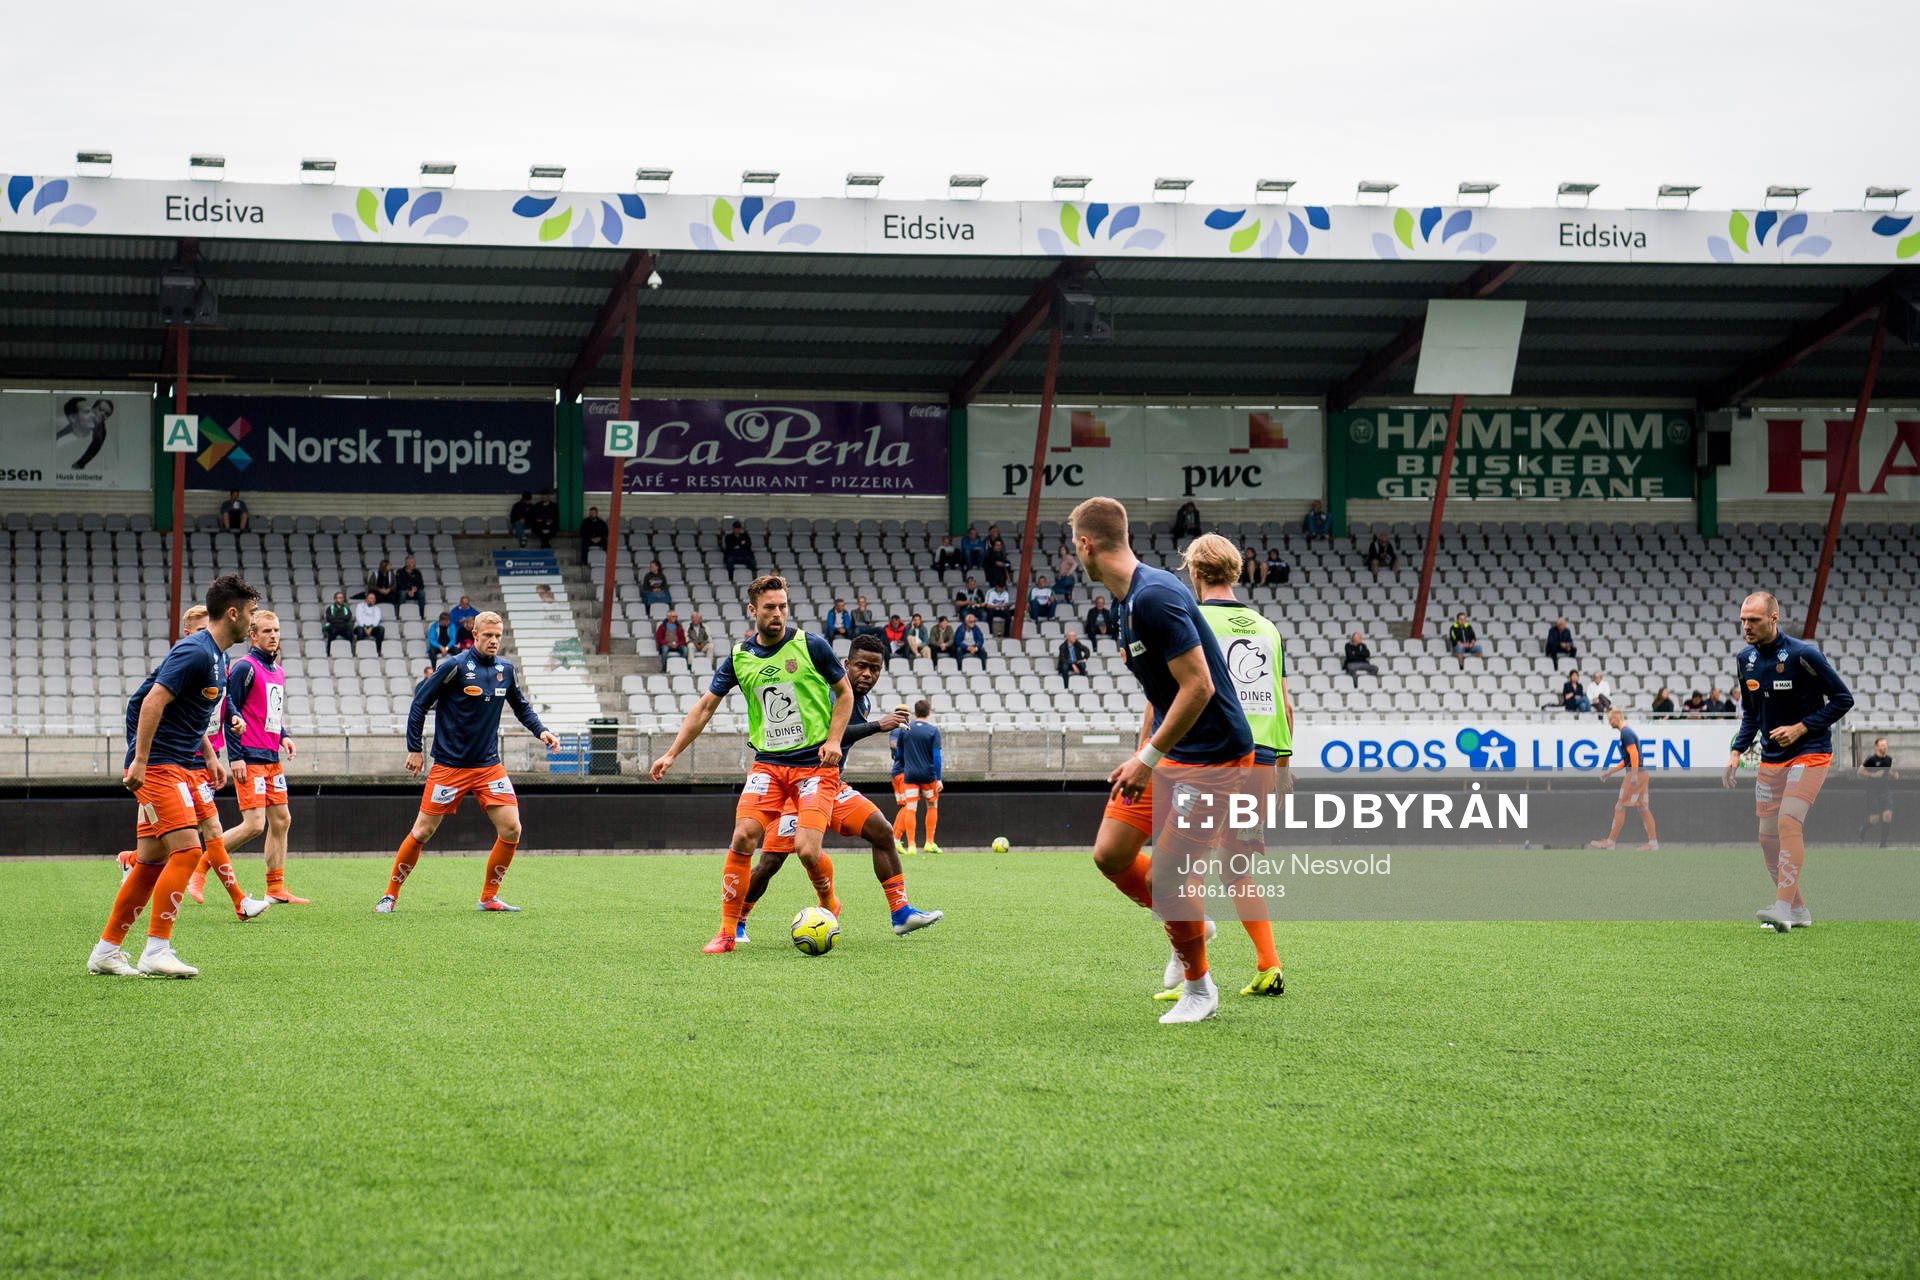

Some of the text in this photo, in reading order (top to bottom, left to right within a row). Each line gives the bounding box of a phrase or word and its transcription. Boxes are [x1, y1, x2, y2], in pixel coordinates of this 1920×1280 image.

[165, 195, 265, 223] Eidsiva
[883, 214, 975, 241] Eidsiva
[1559, 222, 1647, 249] Eidsiva
[166, 418, 194, 446] A
[609, 424, 634, 451] B
[624, 406, 915, 468] La Perla
[1377, 412, 1663, 449] HAM-KAM
[267, 426, 532, 474] Norsk Tipping
[1396, 454, 1643, 476] BRISKEBY
[686, 474, 809, 489] RESTAURANT
[831, 476, 915, 490] PIZZERIA
[1002, 462, 1084, 496] pwc
[1182, 463, 1263, 497] pwc
[1376, 477, 1665, 498] GRESSBANE
[1231, 627, 1257, 635] umbro
[1240, 690, 1272, 702] DINER
[774, 724, 803, 738] DINER
[1320, 739, 1447, 773] OBOS
